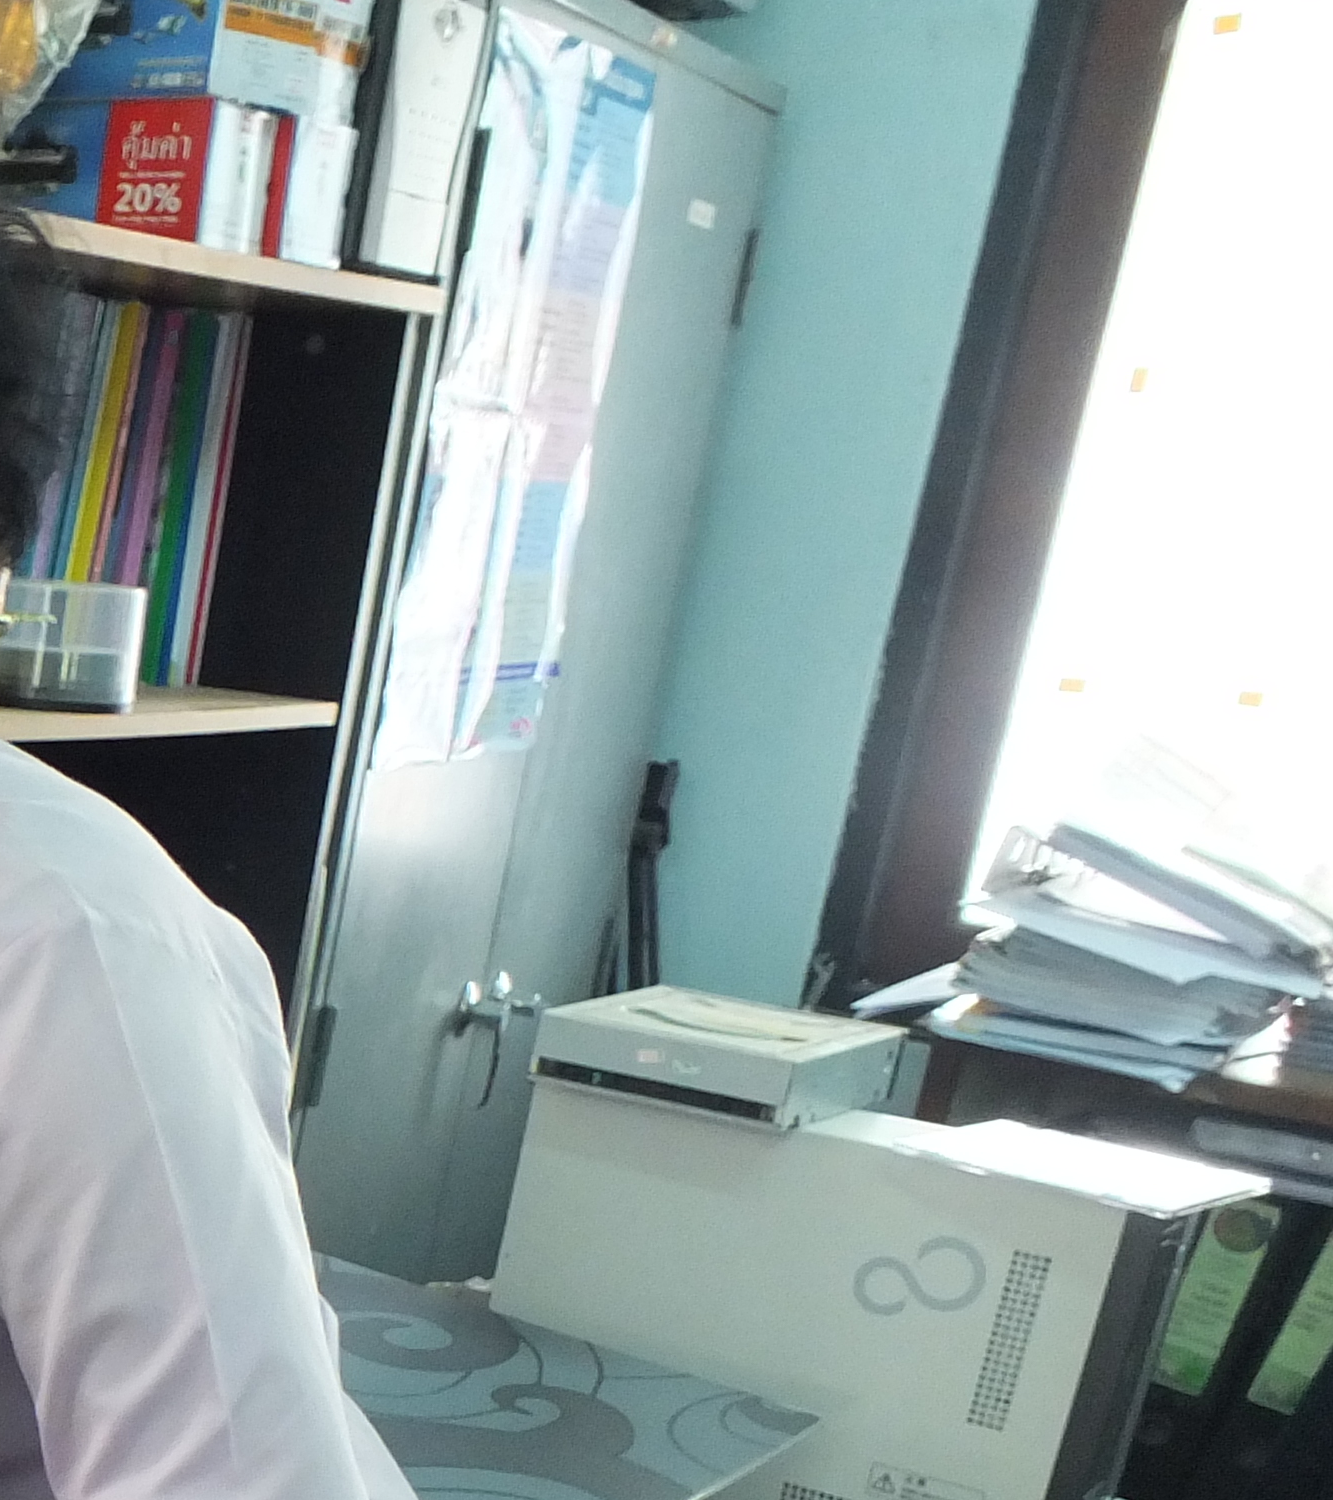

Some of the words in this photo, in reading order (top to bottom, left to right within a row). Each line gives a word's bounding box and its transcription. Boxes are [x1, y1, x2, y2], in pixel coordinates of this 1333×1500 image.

[121, 120, 192, 170] คุ้มค่า
[113, 182, 182, 213] 20%
